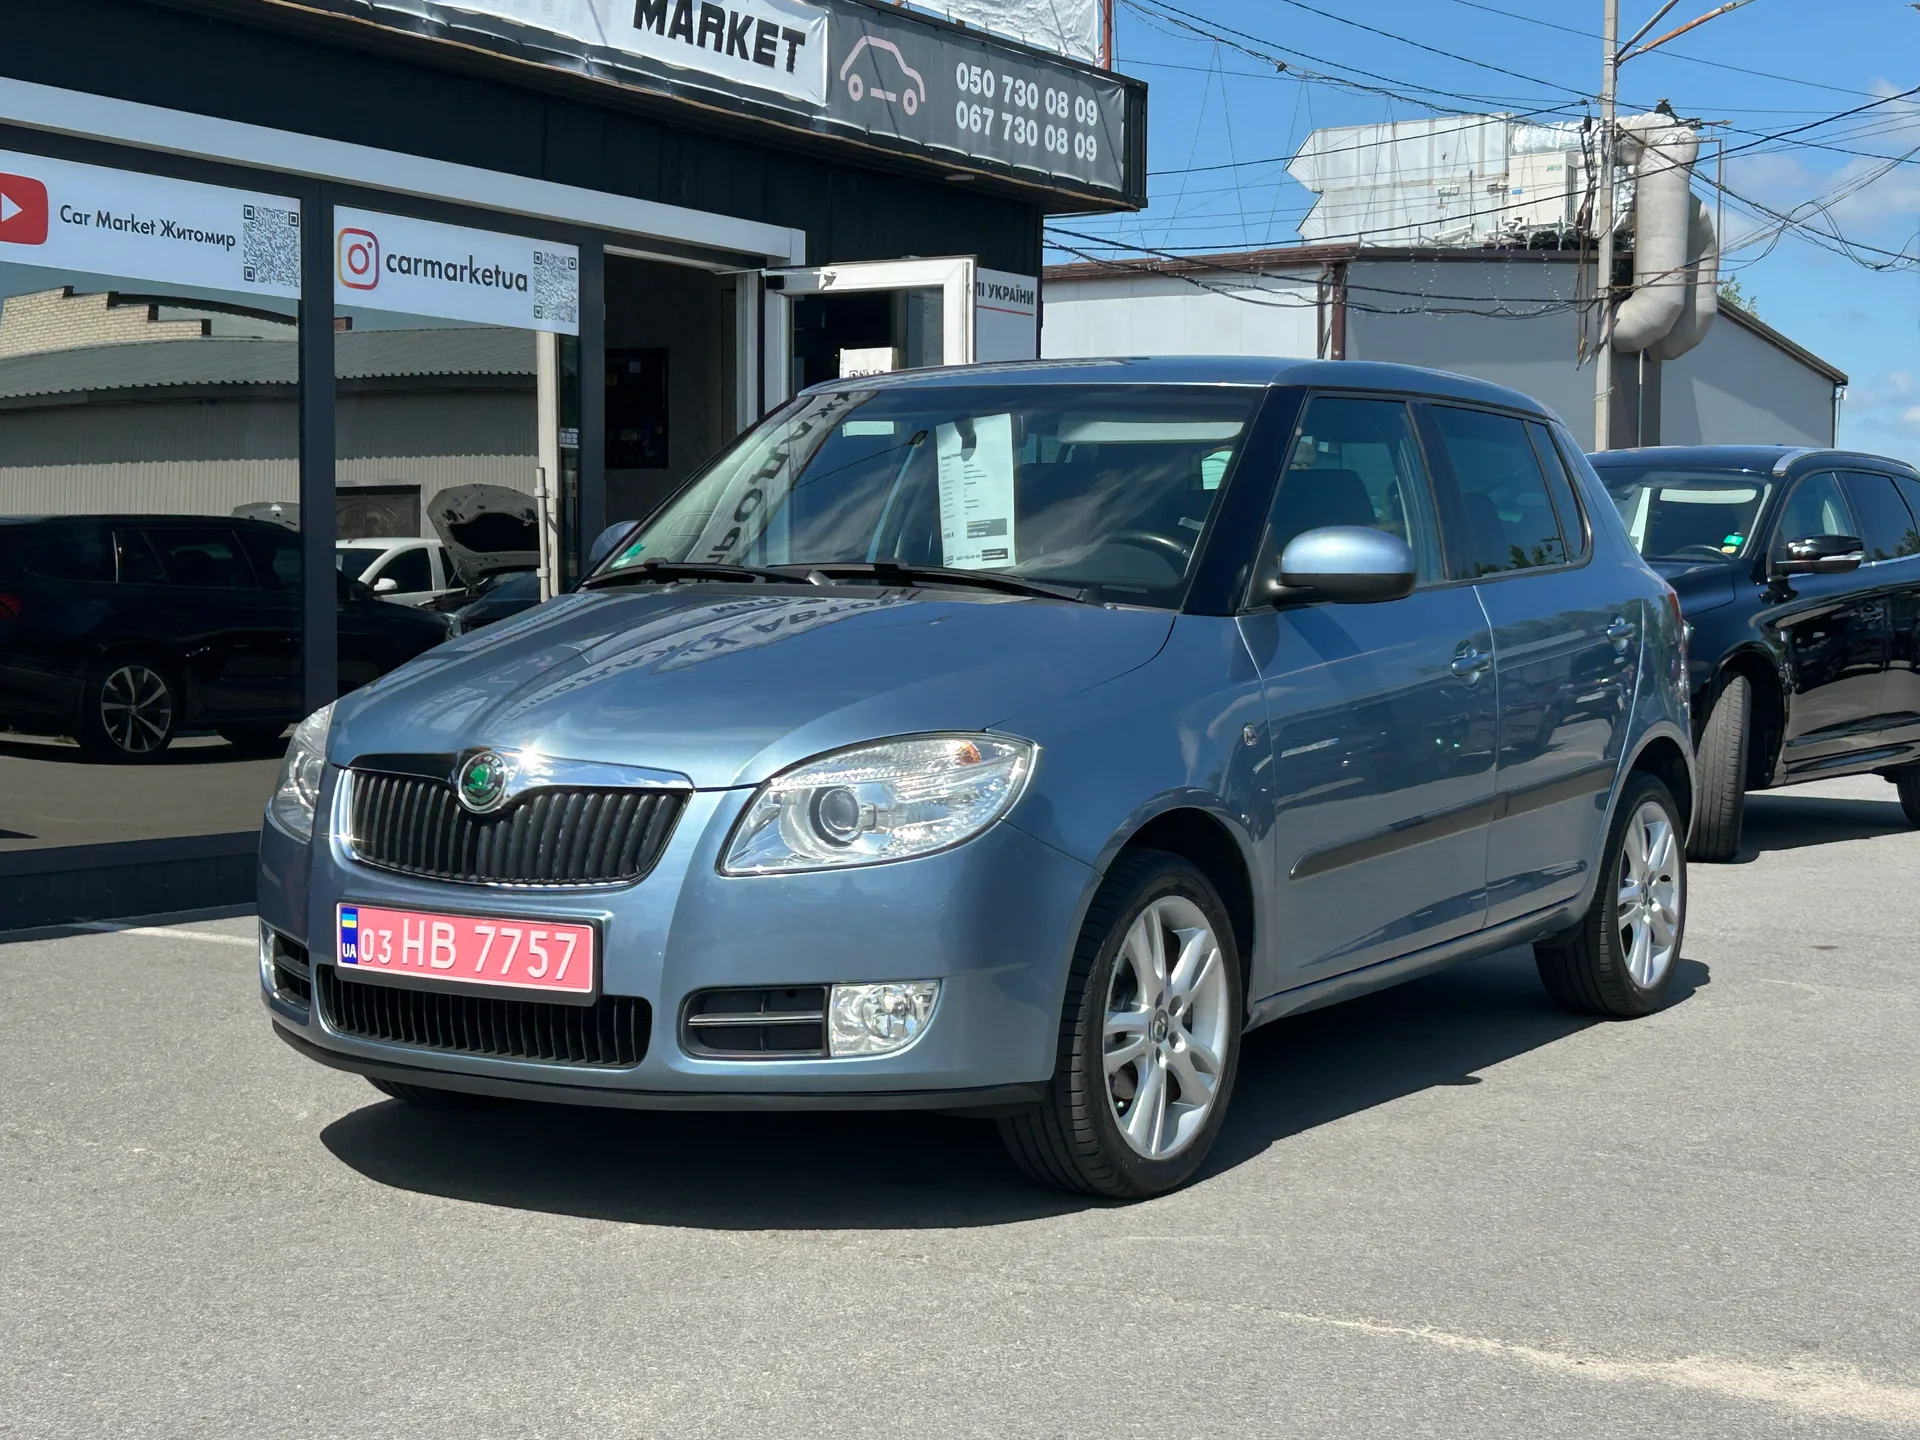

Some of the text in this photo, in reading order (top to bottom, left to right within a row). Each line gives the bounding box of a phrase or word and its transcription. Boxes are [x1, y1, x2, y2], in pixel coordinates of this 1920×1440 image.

[632, 0, 807, 74] MARKET
[956, 62, 1098, 126] 050 730 08 09
[956, 101, 1097, 162] 067 730 08 09
[59, 204, 236, 252] Car Market Житомир
[385, 253, 528, 292] carmarketua
[988, 283, 1034, 306] УКРАЇНИ
[342, 942, 358, 959] UA
[360, 918, 578, 981] 03 HB 7757
